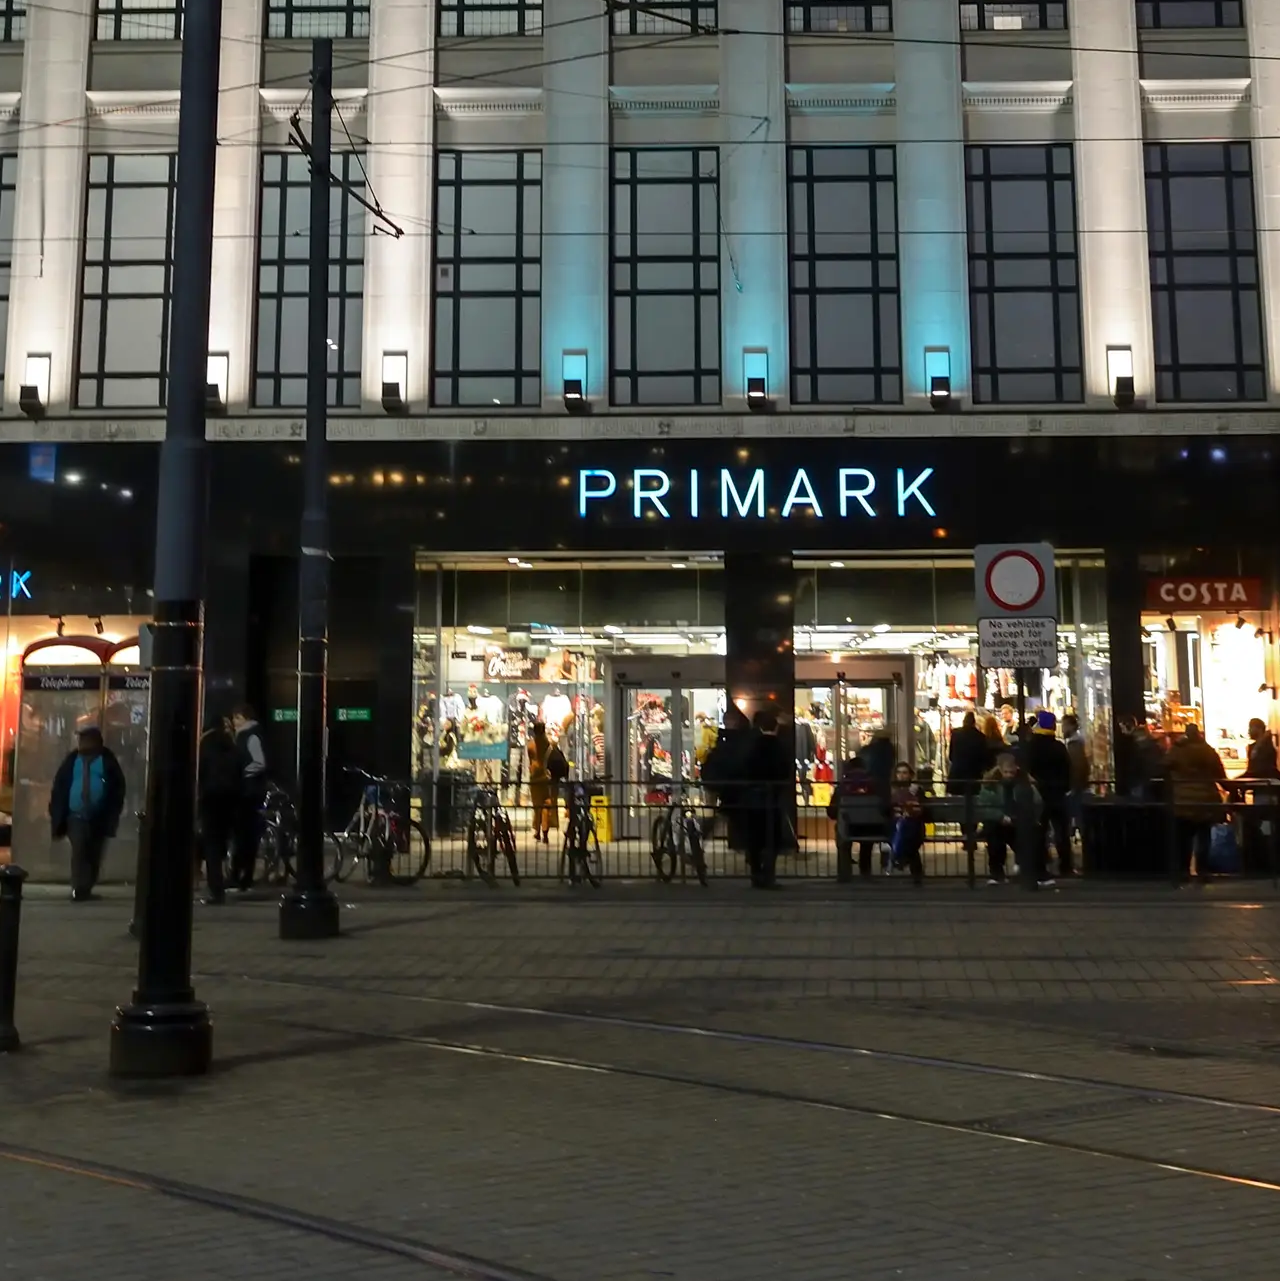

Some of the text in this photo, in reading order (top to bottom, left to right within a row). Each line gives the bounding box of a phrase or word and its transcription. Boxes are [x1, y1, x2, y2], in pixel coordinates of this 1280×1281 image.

[579, 467, 937, 518] PRIMARK
[1160, 582, 1248, 605] COSTA
[988, 619, 1046, 629] No vehicles
[992, 629, 1043, 639] except for
[1022, 638, 1054, 649] cycles
[991, 649, 1046, 659] and permit
[999, 657, 1037, 667] holders
[40, 676, 86, 690] Telephone
